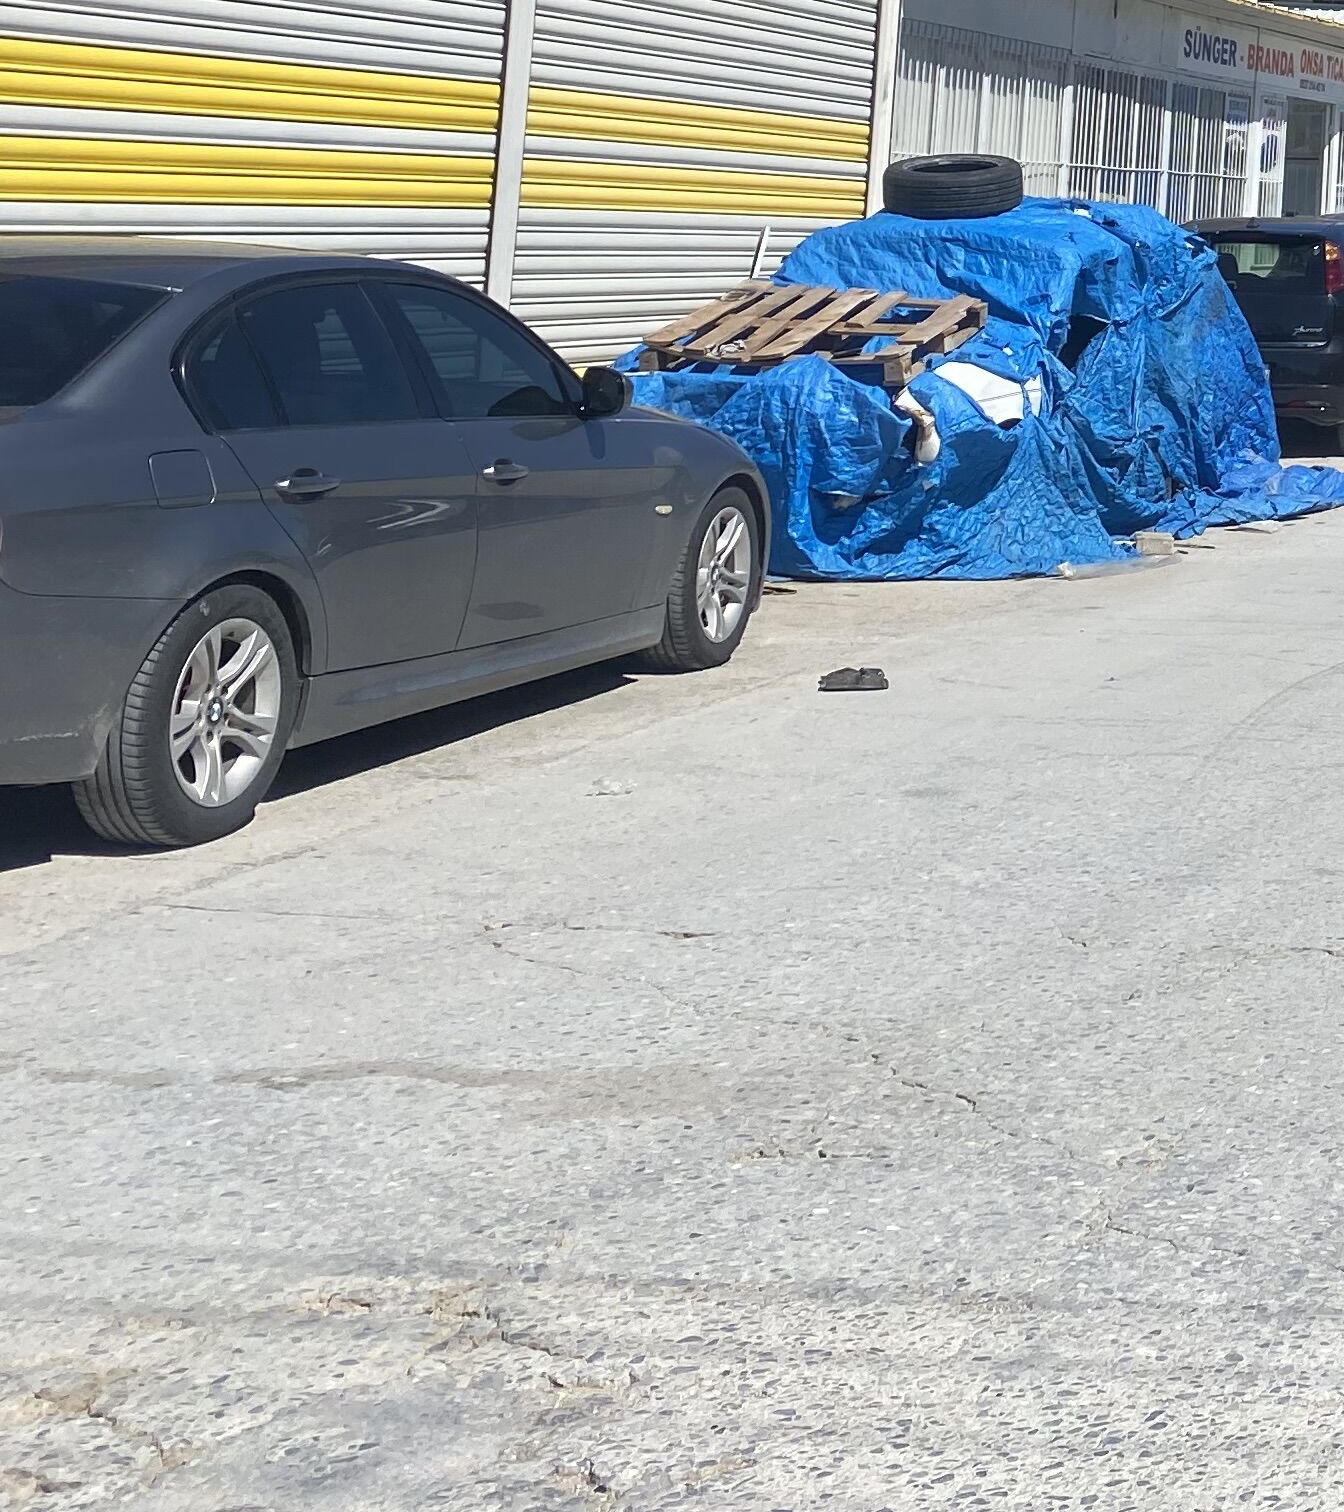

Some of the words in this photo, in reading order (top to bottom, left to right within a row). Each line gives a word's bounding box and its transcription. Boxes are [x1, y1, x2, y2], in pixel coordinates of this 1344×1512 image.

[1183, 25, 1237, 67] SÜNGER
[1247, 43, 1294, 78] BRANDA
[1300, 48, 1324, 78] ONSA
